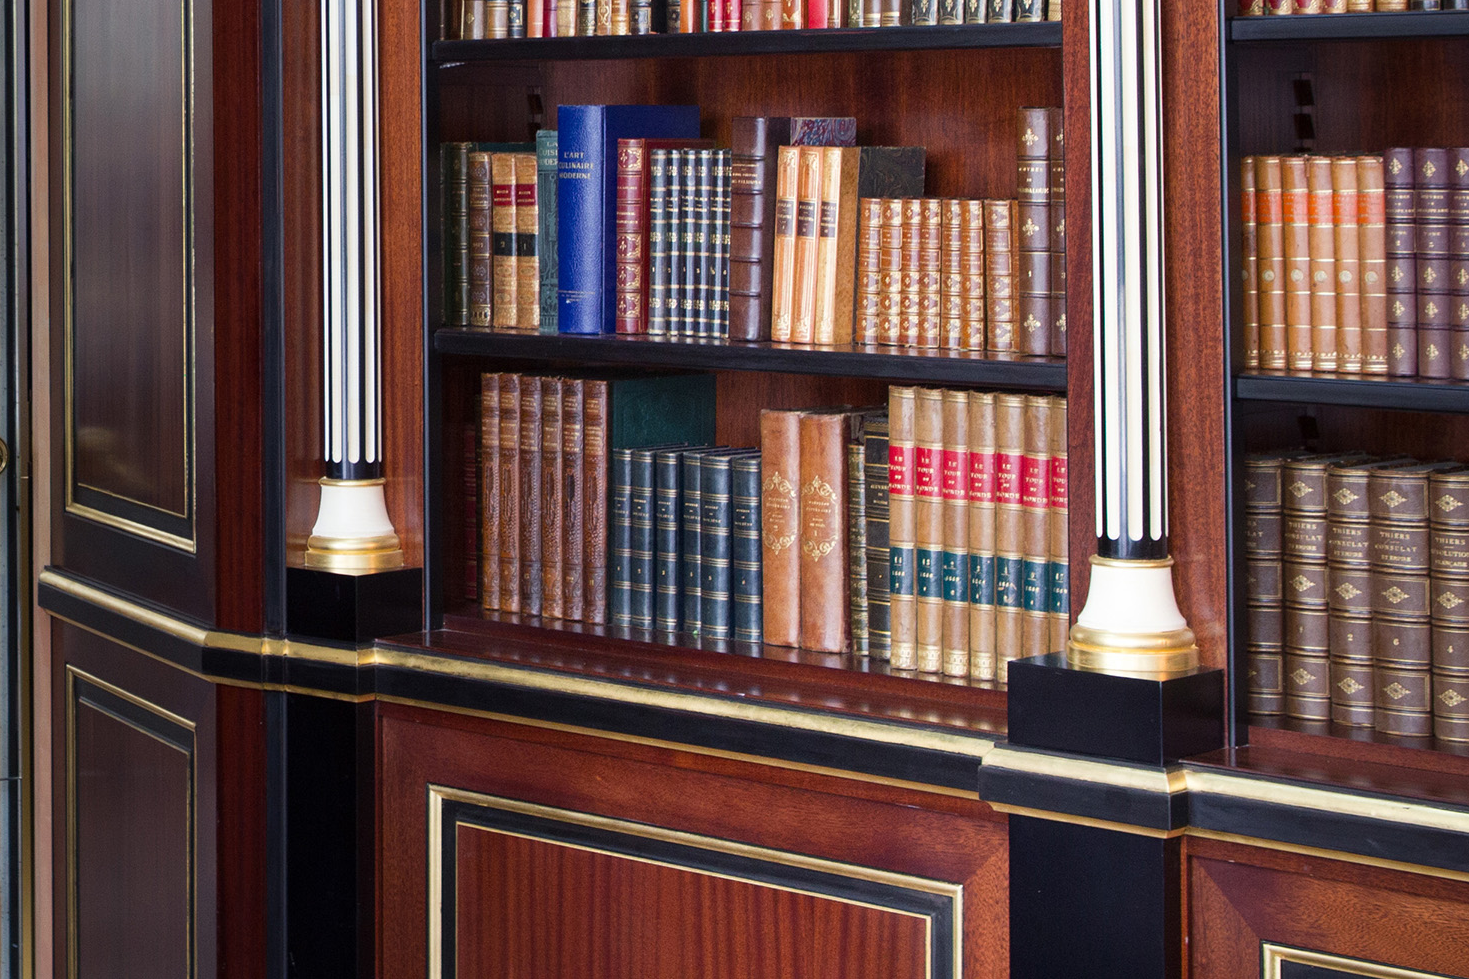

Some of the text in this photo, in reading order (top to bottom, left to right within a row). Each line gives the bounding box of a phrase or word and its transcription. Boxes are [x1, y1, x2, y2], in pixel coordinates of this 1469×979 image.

[563, 151, 584, 159] L'ART
[558, 161, 595, 170] CULINAIRE
[559, 172, 592, 180] MODERNE
[1288, 521, 1317, 530] THIERS
[1332, 527, 1363, 536] THIERS
[1379, 531, 1411, 540] THIERS
[1329, 539, 1369, 548] CONSULAT
[1435, 536, 1466, 546] THIERS
[1374, 544, 1418, 553] CONSULAT
